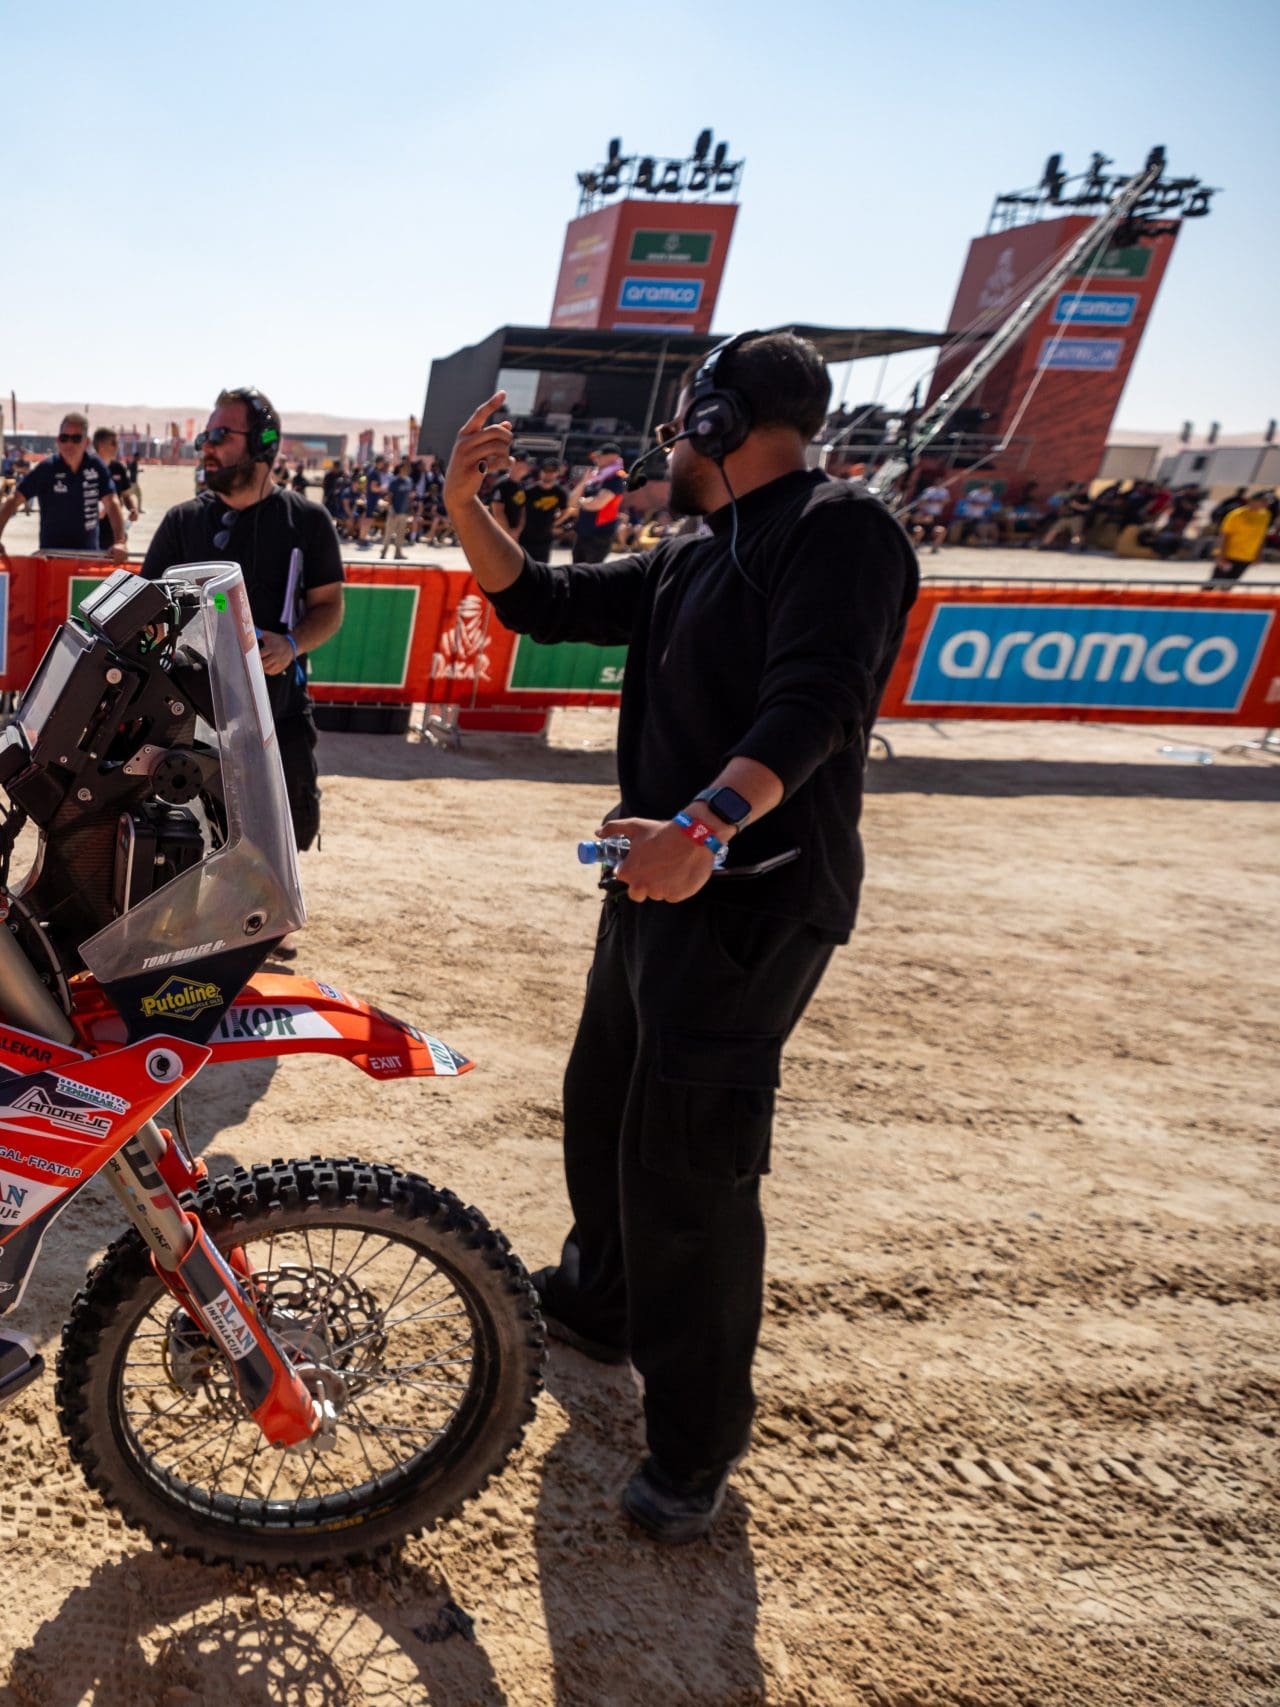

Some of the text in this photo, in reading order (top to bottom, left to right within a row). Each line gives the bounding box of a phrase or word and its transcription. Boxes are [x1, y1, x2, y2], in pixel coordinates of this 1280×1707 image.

[626, 283, 695, 303] aramco
[938, 629, 1239, 685] aramco
[143, 984, 217, 1016] Putoline
